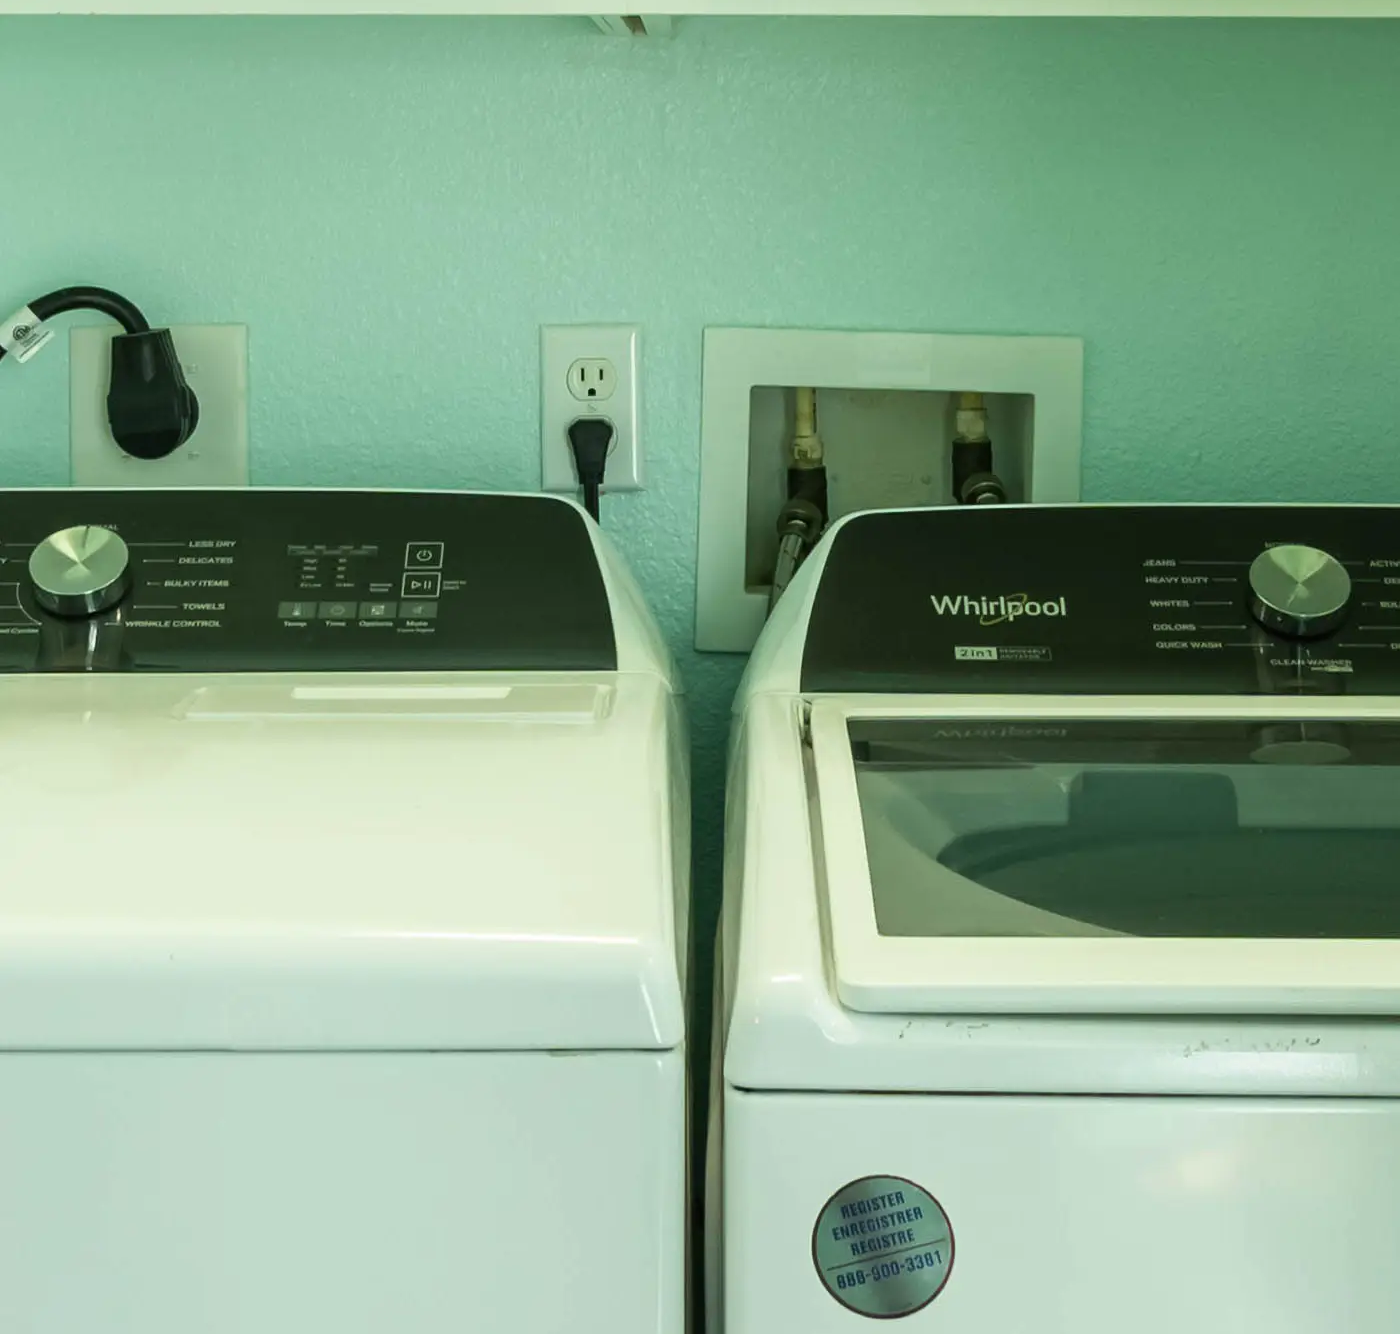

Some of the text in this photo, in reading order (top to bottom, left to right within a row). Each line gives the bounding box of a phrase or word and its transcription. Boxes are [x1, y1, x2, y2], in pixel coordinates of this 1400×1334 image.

[188, 540, 237, 548] LESS DRY
[178, 557, 234, 565] DELICATES
[1143, 559, 1176, 567] JEANS
[1145, 576, 1209, 584] HEAVY DUTY
[182, 603, 226, 611] TOWELS
[1150, 600, 1190, 608] WHITES
[930, 595, 1067, 622] Whirlpool
[125, 620, 222, 628] WRINKLE CONTROL
[1153, 623, 1196, 631] COLORS
[1156, 641, 1223, 649] QUICK WASH
[840, 1191, 905, 1219] REGISTER
[832, 1206, 923, 1242] ENREGISTRER
[851, 1228, 916, 1256] REGISTRE
[836, 1250, 943, 1290] 888-900-3381
